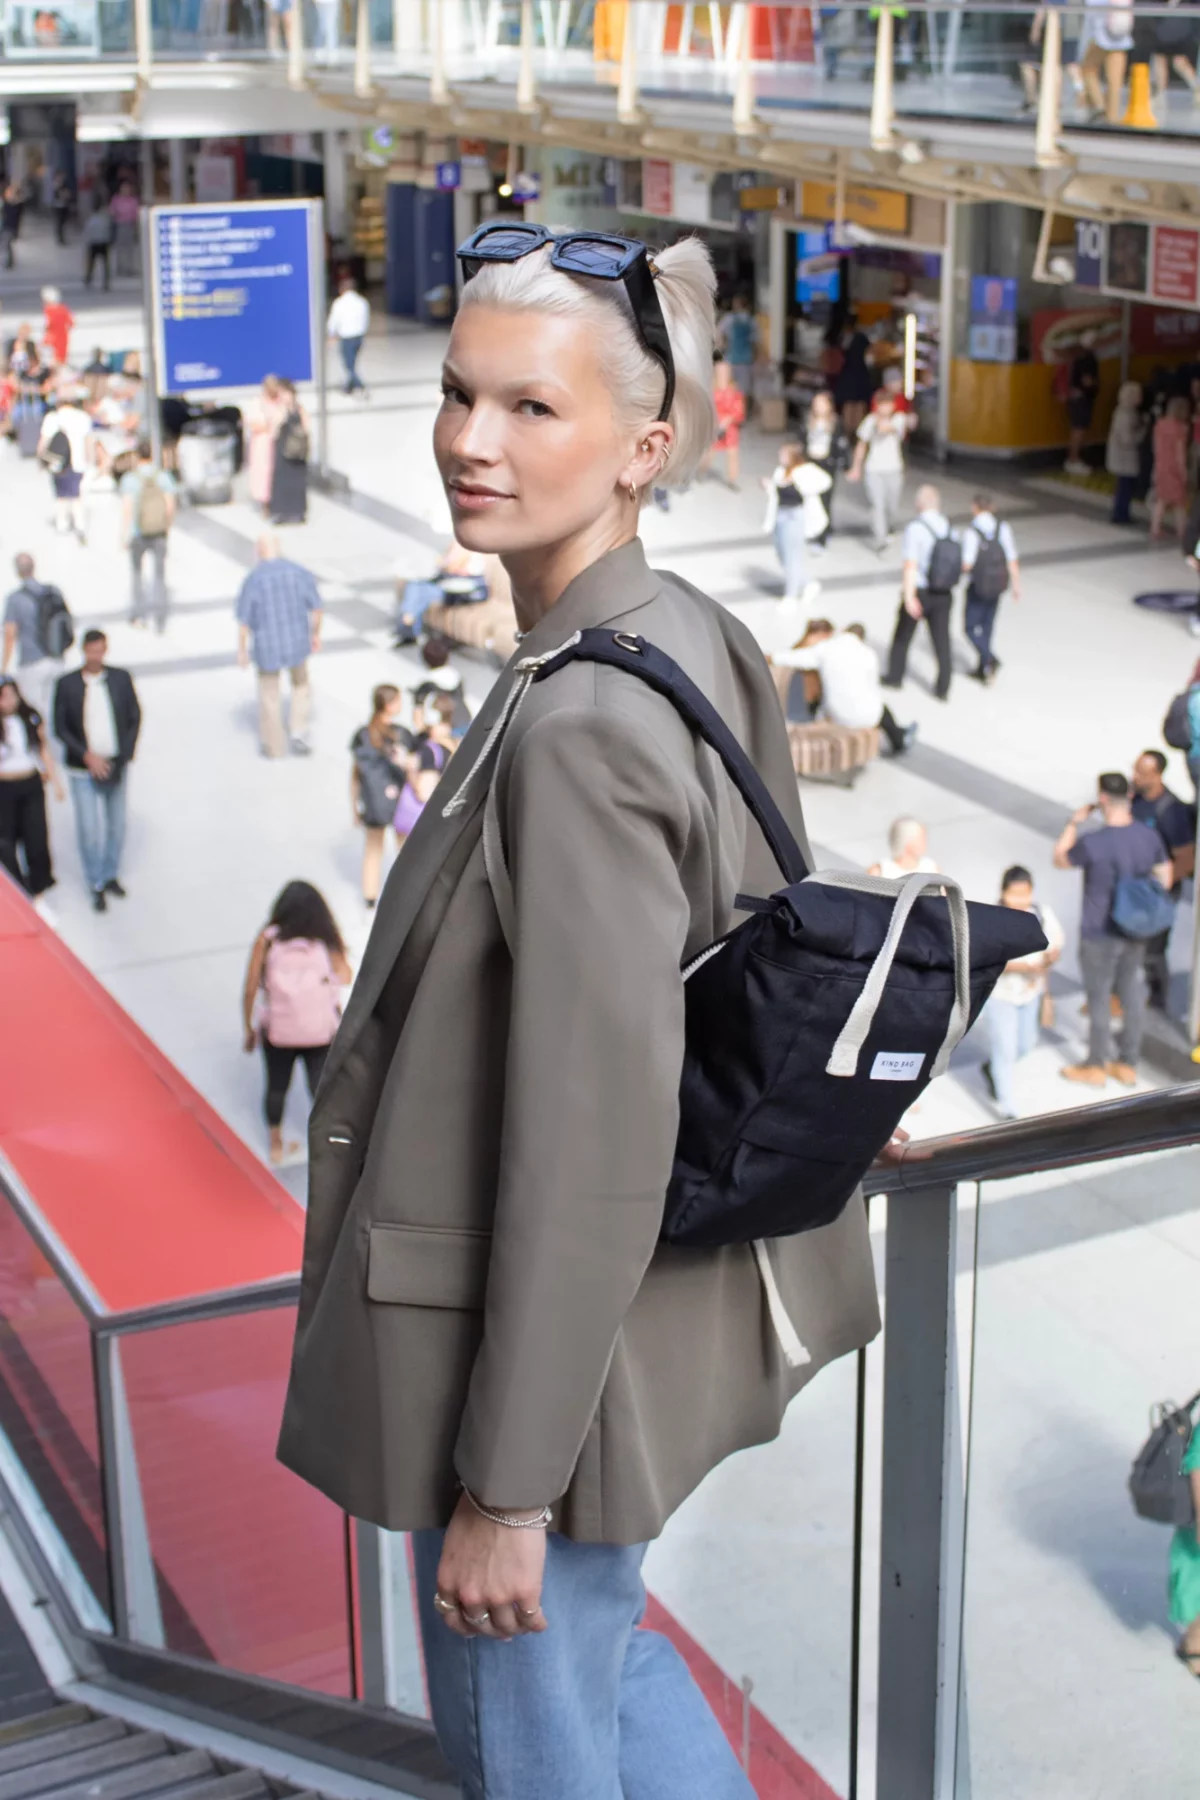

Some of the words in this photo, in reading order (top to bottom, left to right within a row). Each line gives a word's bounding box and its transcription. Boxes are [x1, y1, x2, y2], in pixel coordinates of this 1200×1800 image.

[1076, 221, 1103, 259] 10
[881, 1060, 899, 1068] KIND
[901, 1060, 915, 1068] BAG
